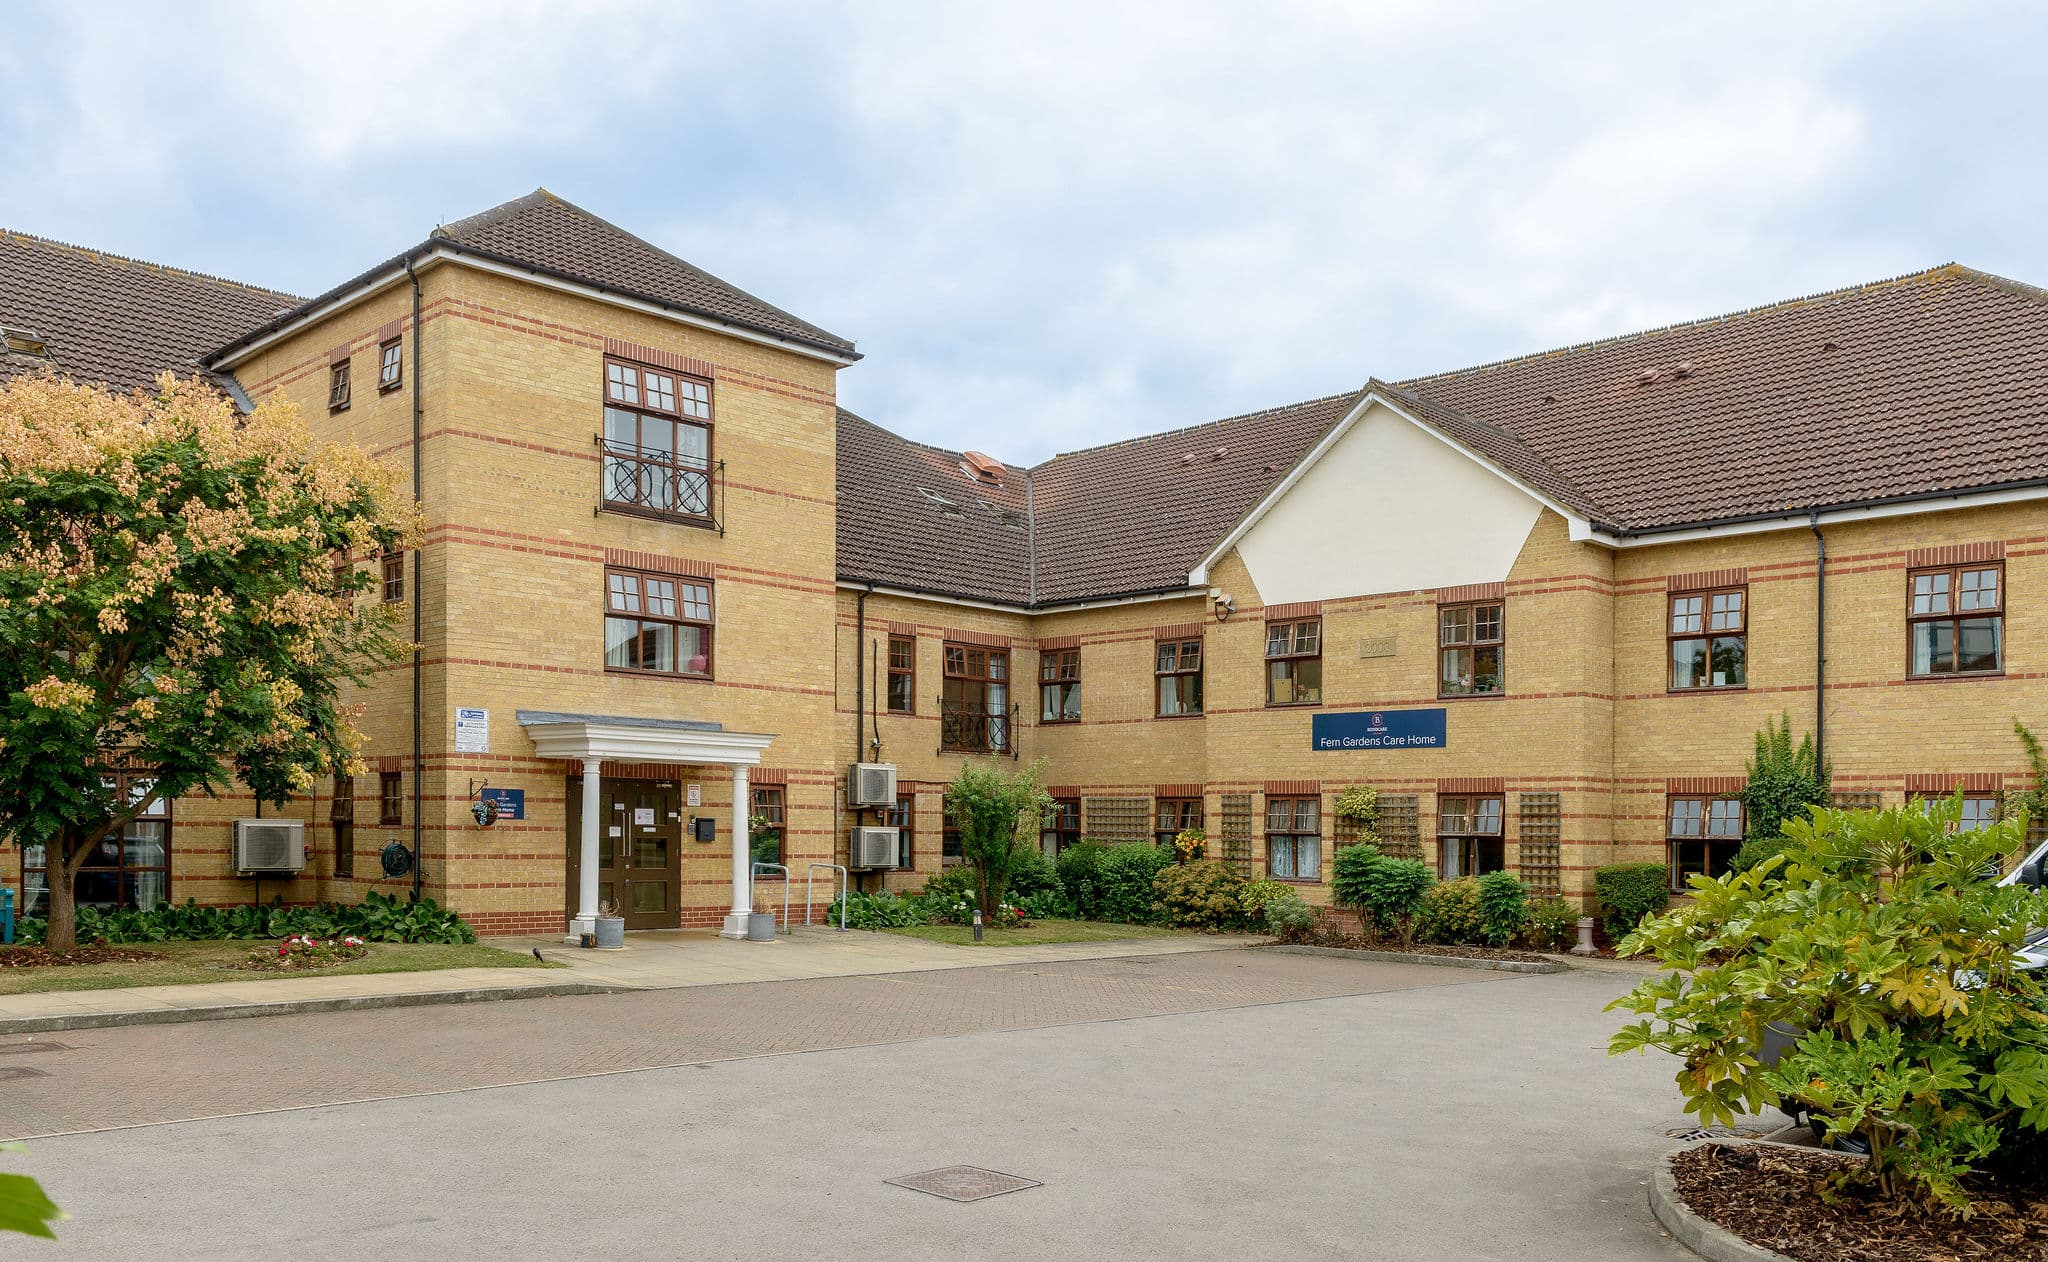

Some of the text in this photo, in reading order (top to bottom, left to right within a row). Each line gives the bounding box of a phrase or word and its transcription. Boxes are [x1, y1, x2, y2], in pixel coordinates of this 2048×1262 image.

[1320, 734, 1437, 748] Fern Gardens Care Home
